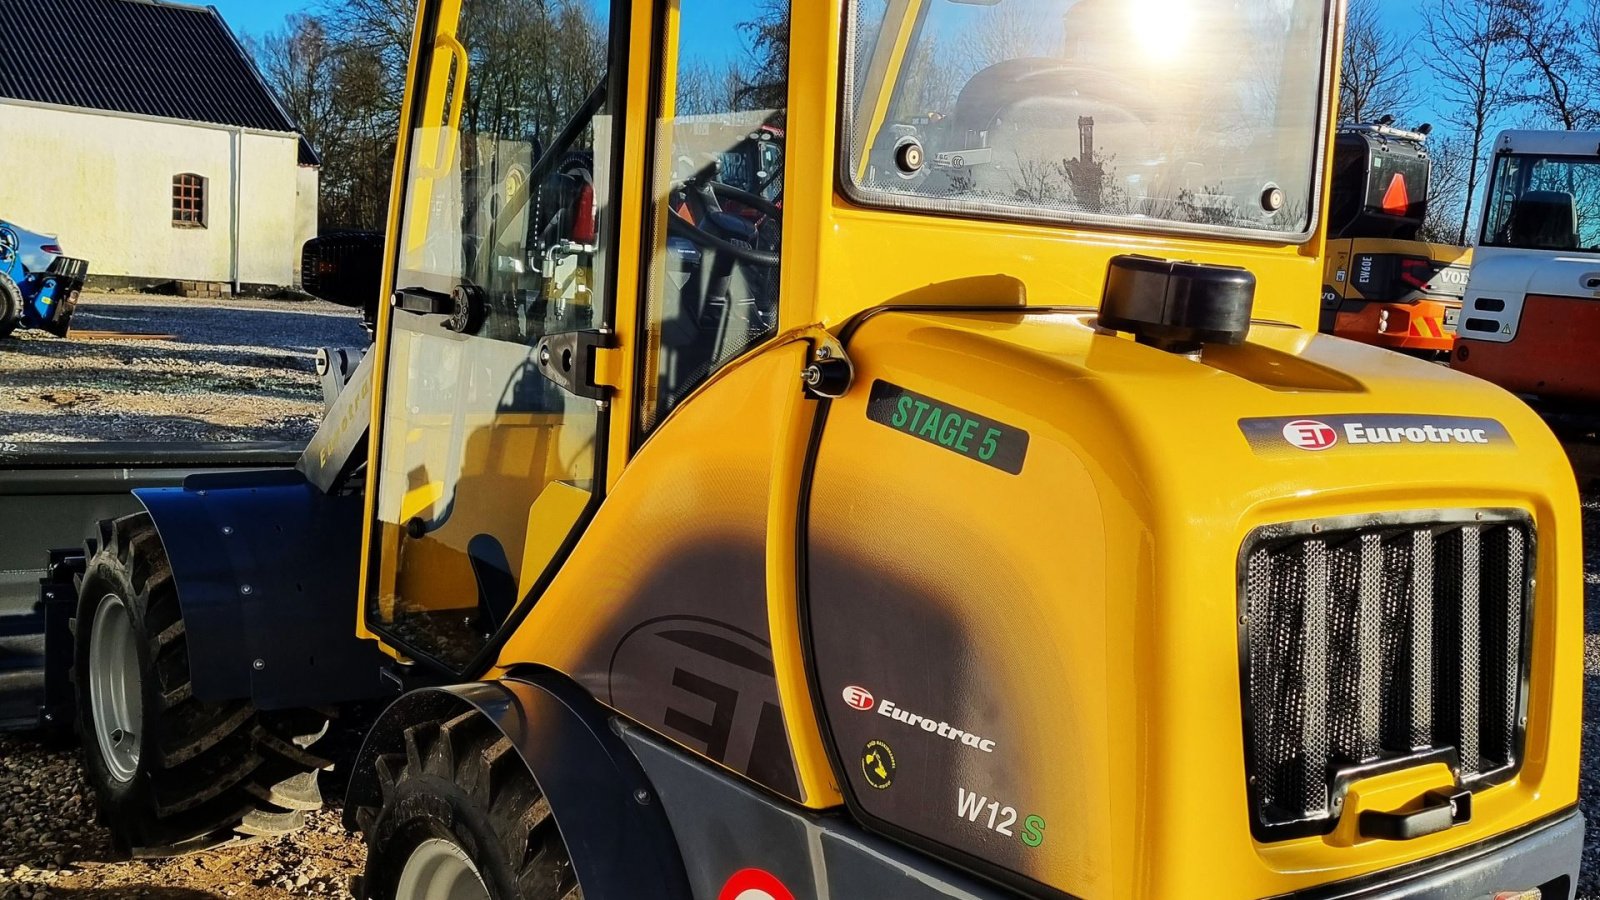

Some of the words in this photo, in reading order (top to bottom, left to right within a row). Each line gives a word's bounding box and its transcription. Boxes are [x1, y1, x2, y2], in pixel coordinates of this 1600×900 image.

[1360, 256, 1372, 283] EW60E
[1440, 270, 1469, 285] VOL
[319, 377, 370, 469] Eurotra
[892, 395, 980, 453] STAGE
[978, 427, 1002, 461] 5
[1290, 421, 1335, 449] ET
[1343, 422, 1489, 445] Eurotrac
[846, 687, 872, 709] ET
[877, 699, 997, 753] Eurotrac
[957, 787, 1018, 838] W12
[1020, 814, 1047, 848] S
